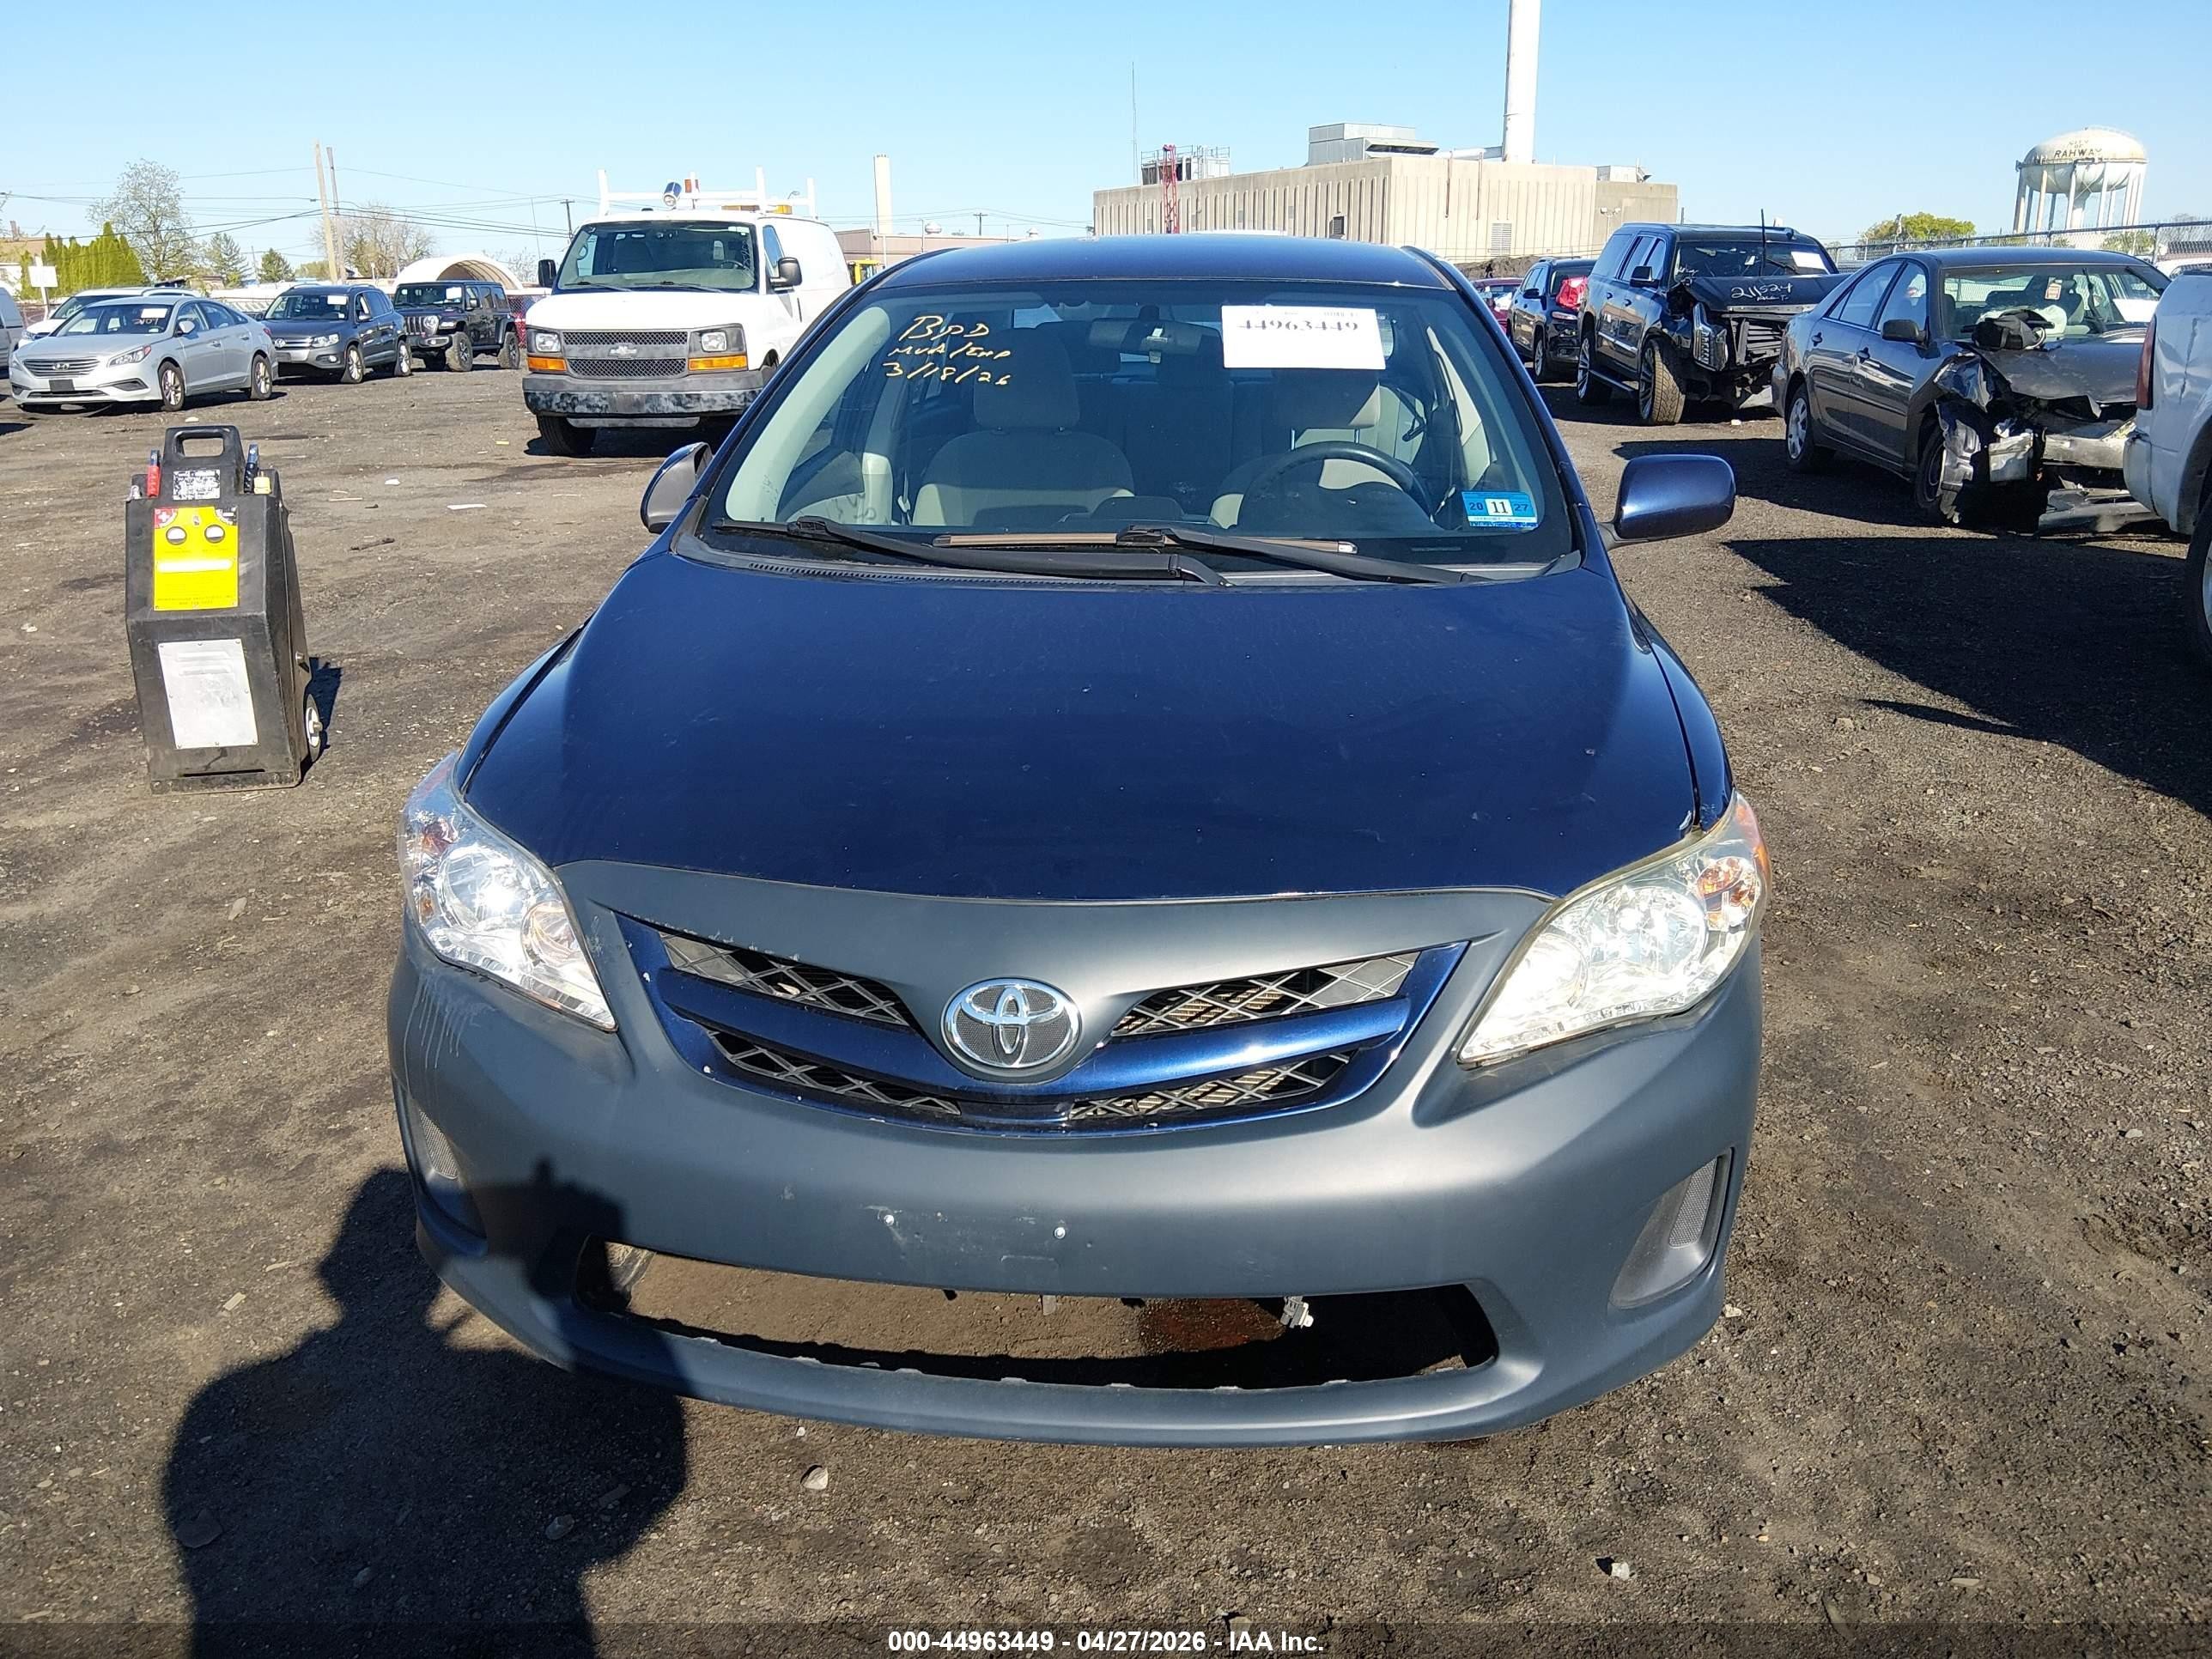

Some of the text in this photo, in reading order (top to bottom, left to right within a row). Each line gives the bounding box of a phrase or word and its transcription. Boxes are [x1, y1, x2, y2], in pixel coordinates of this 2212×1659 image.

[2054, 149, 2102, 158] RAHWAY
[1237, 319, 1359, 331] 44963449
[883, 362, 1011, 385] 3/18/26
[1491, 501, 1509, 514] 11
